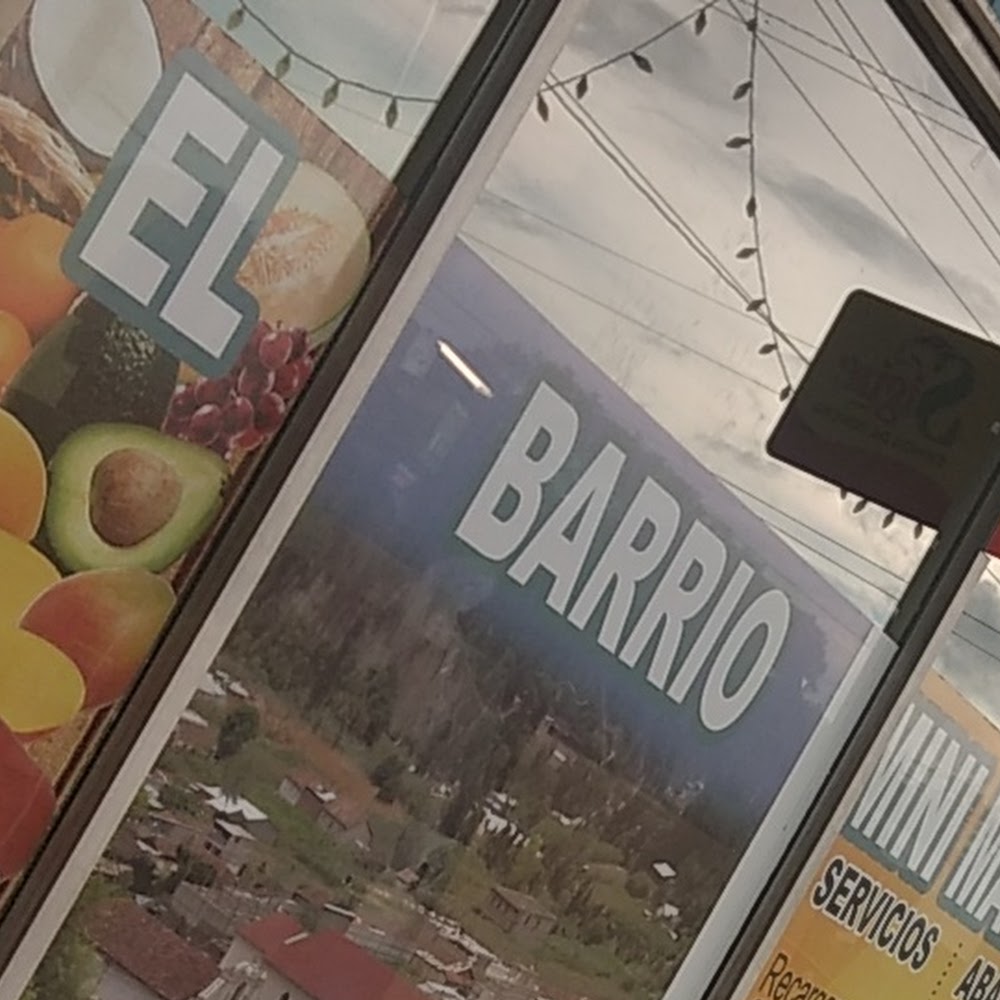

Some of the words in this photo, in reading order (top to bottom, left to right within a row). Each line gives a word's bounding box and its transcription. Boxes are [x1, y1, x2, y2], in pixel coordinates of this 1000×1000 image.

[80, 71, 285, 360] EL
[455, 381, 791, 732] BARRIO
[812, 856, 941, 971] SERVICIOS
